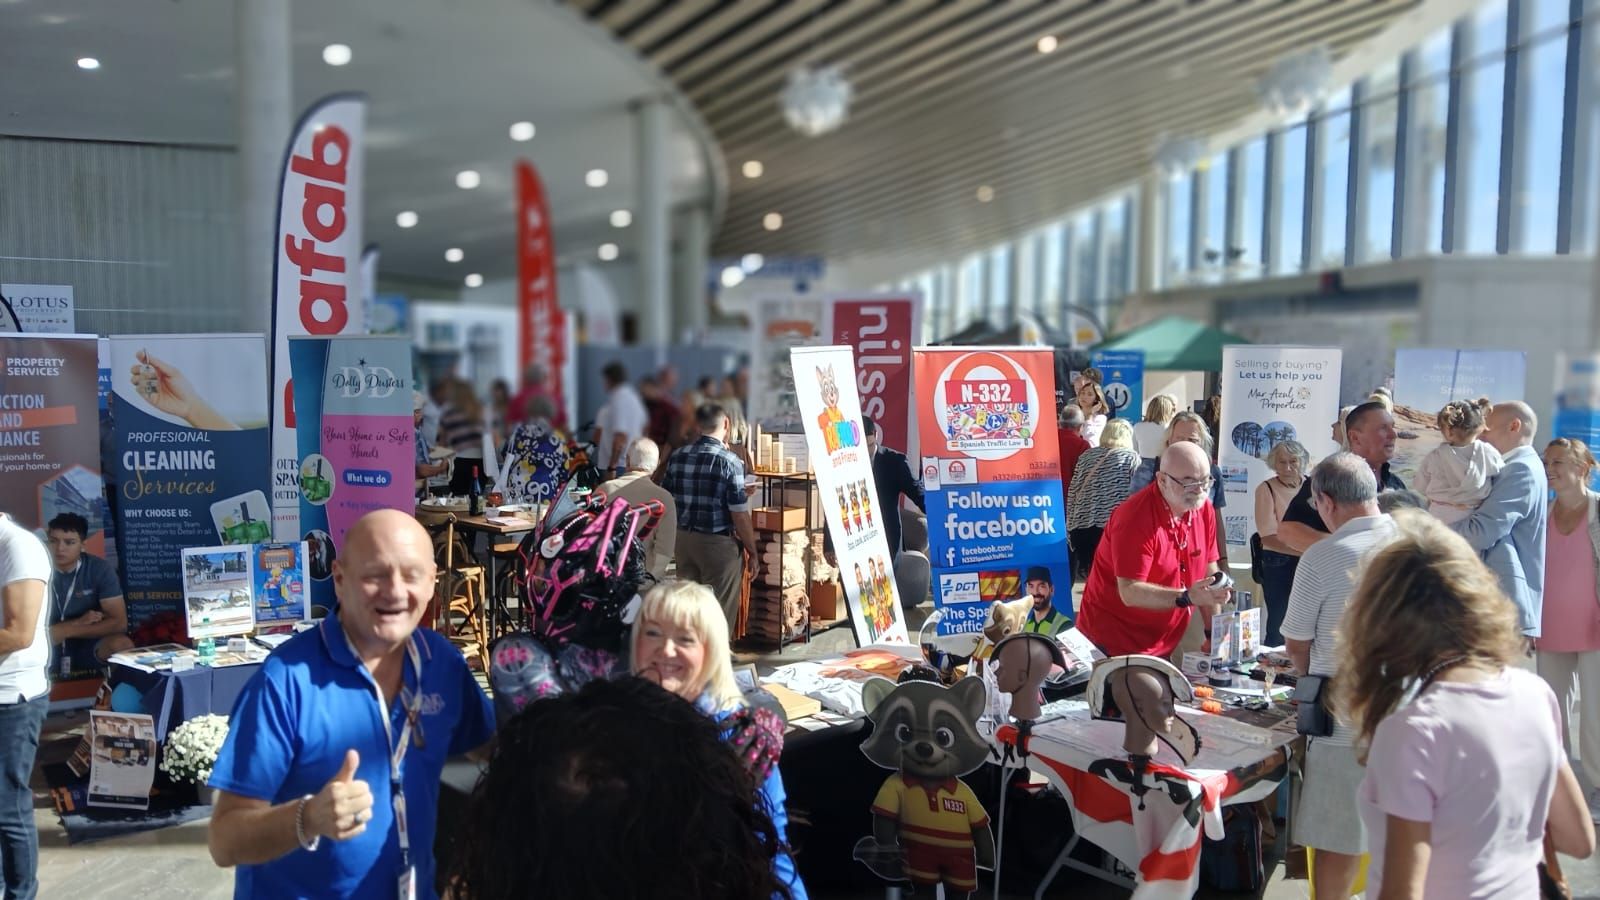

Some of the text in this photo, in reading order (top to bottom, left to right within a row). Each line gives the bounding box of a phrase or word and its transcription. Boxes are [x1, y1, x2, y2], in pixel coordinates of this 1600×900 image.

[8, 296, 69, 308] LOTUS
[7, 358, 65, 367] PROPERTY
[1234, 360, 1269, 370] Selling
[1272, 361, 1282, 369] or
[7, 367, 60, 376] SERVICES
[1240, 371, 1256, 379] Let
[1275, 371, 1299, 381] help
[1302, 373, 1323, 381] you
[332, 373, 361, 394] Dolly
[961, 383, 1012, 402] N-332
[1248, 386, 1294, 400] Mar Azul
[0, 394, 45, 409] CTION
[1260, 398, 1306, 413] Properties
[127, 431, 211, 443] PROFESIONAL
[376, 431, 386, 441] in
[388, 428, 409, 445] Safe
[959, 441, 986, 449] Spanish
[986, 440, 1010, 448] Traffic
[33, 452, 45, 460] for
[122, 450, 216, 471] CLEANING
[5, 465, 24, 473] your
[26, 463, 50, 471] home
[123, 467, 216, 500] Services
[346, 472, 387, 484] What we do
[947, 490, 1052, 510] Follow us on
[124, 509, 192, 518] WHY CHOOSE US:
[944, 510, 1056, 541] facebook
[961, 543, 1014, 557] facebook.com/
[955, 582, 979, 592] DGT
[943, 606, 966, 620] The
[944, 800, 964, 813] N332
